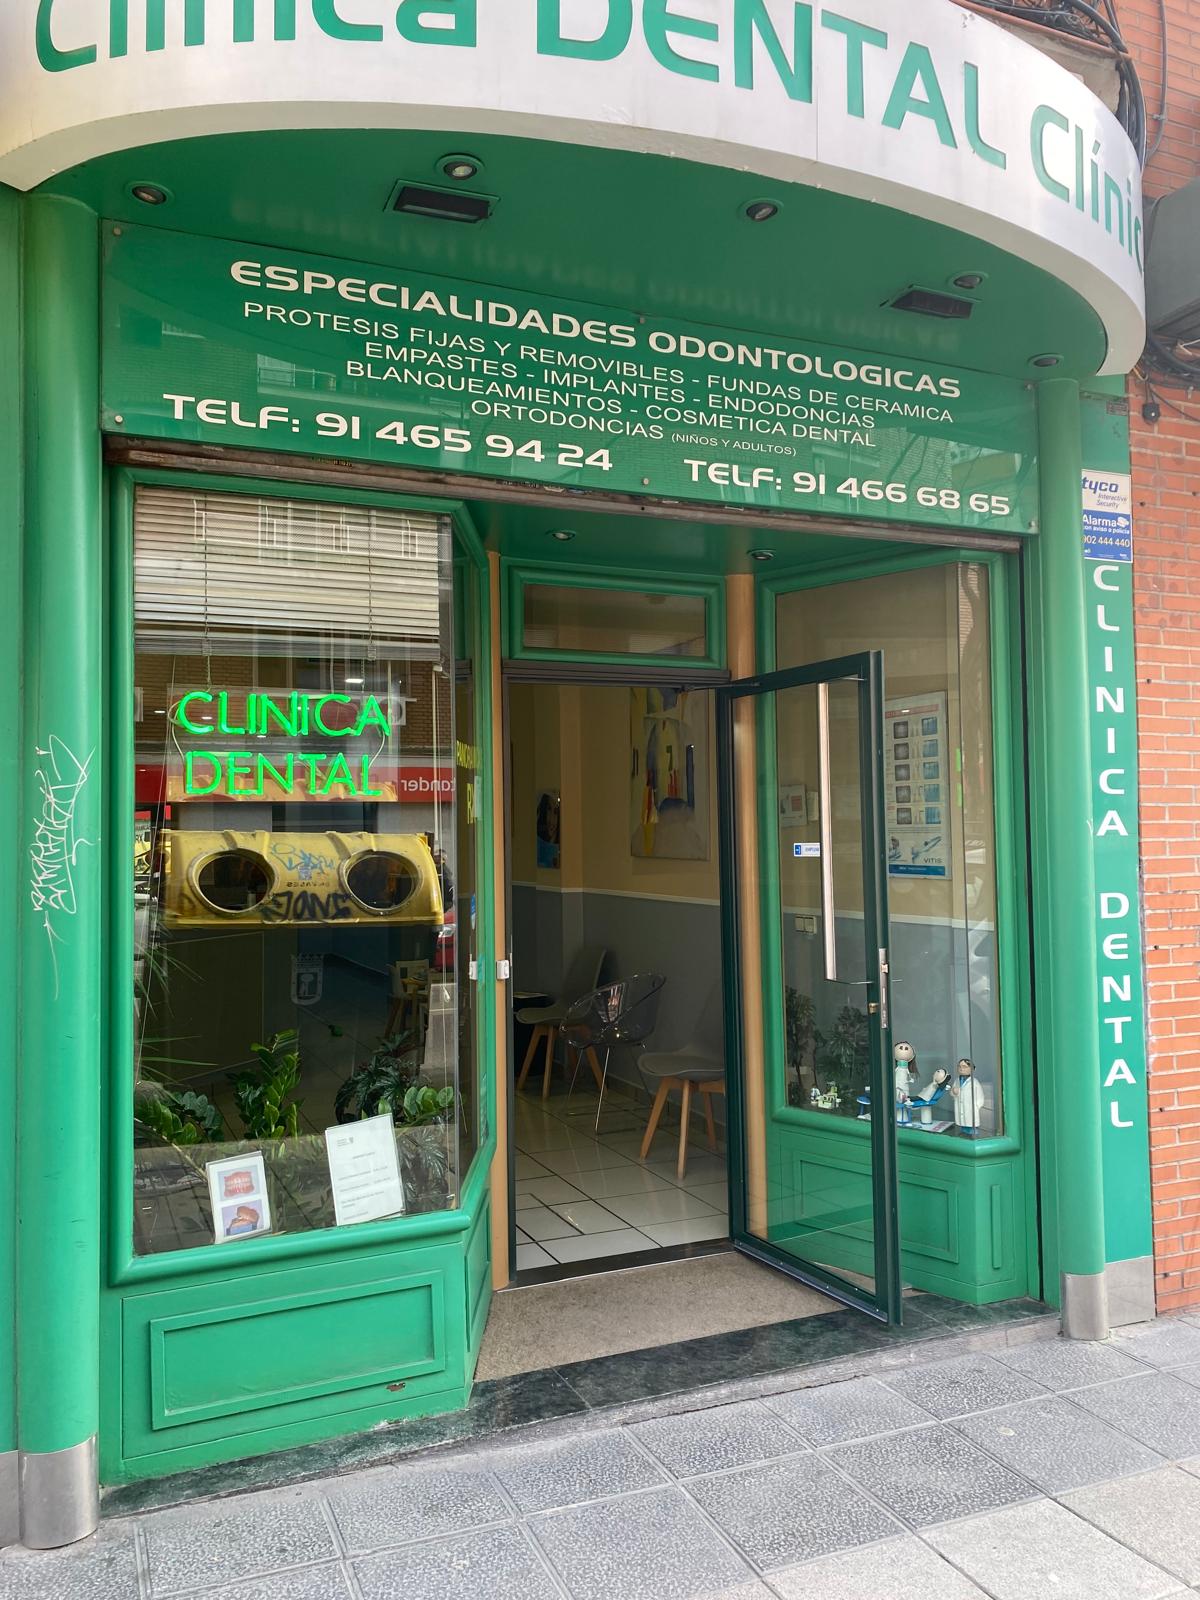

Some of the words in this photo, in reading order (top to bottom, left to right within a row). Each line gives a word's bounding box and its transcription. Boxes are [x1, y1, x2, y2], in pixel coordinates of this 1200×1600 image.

[537, 0, 1007, 170] DENTAL
[230, 261, 636, 348] ESPECIALIDADES
[648, 331, 961, 398] ODONTOLOGICAS
[244, 301, 399, 339] PROTESIS
[410, 327, 485, 353] FIJAS
[494, 340, 511, 356] Y
[520, 345, 684, 384] REMOVIBLES
[708, 375, 801, 400] FUNDAS
[809, 389, 838, 406] DE
[845, 395, 953, 423] CERAMICA
[366, 342, 517, 378] EMPASTES
[544, 369, 685, 403] IMPLANTES
[708, 394, 875, 428] ENDODONCIAS
[163, 393, 300, 433] TELF:
[316, 412, 360, 440] 91
[376, 421, 472, 453] 465
[486, 434, 546, 463] 94
[557, 443, 613, 471] 24
[347, 361, 622, 414] BLANQUEAMIENTOS
[646, 404, 787, 436] COSMETICA
[792, 424, 876, 447] DENTAL
[471, 400, 664, 439] ORTODONCIAS
[671, 432, 718, 447] (NIÑOS
[721, 439, 730, 448] Y
[731, 440, 797, 456] ADULTOS)
[683, 459, 782, 490] TELF:
[793, 472, 826, 495] 91
[836, 478, 908, 503] 466
[916, 487, 961, 510] 68
[969, 493, 1010, 516] 65
[1082, 477, 1118, 493] tyco
[1096, 500, 1120, 508] Security
[1098, 493, 1127, 502] Interactive
[1082, 514, 1117, 527] Alarma
[1098, 536, 1113, 546] 444
[1114, 538, 1131, 548] 440
[177, 691, 391, 736] CLINICA
[1093, 565, 1129, 836] CLINICA
[184, 750, 383, 796] DENTAL
[1101, 892, 1136, 1128] DENTAL
